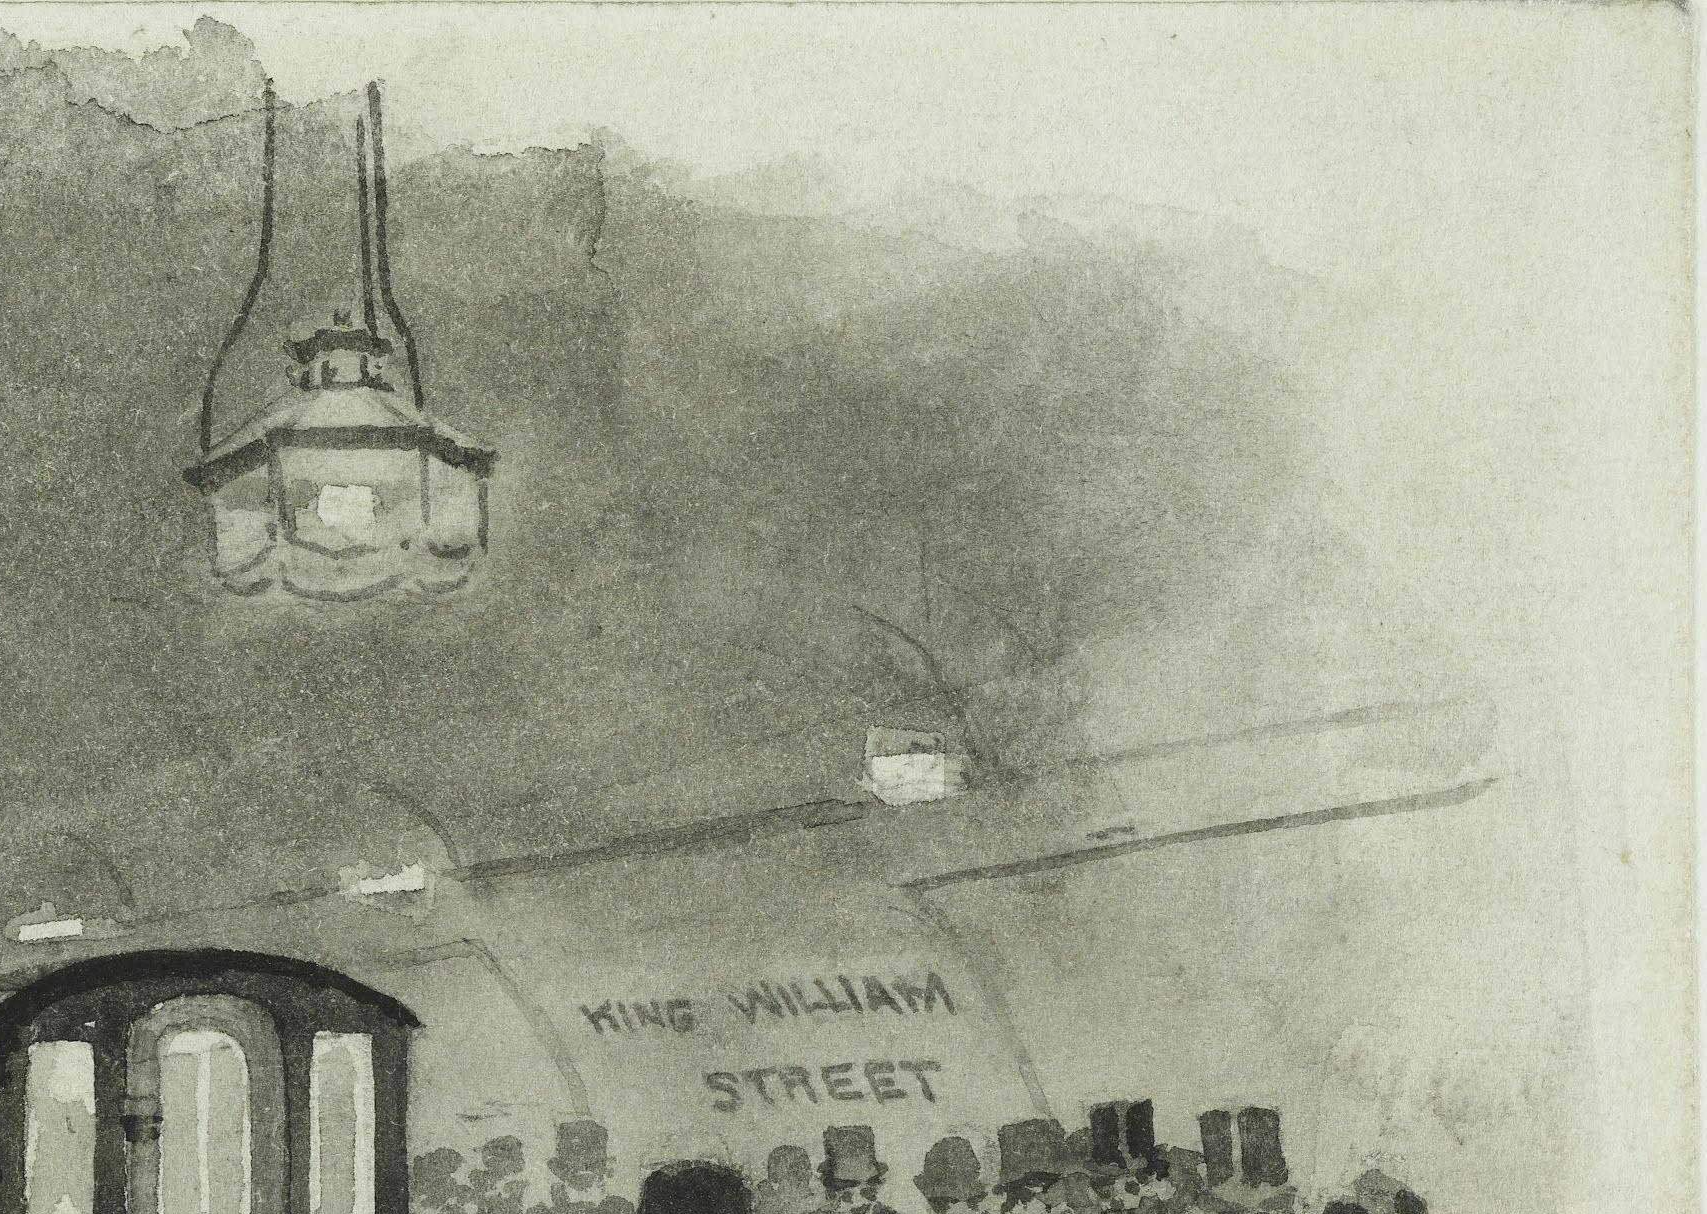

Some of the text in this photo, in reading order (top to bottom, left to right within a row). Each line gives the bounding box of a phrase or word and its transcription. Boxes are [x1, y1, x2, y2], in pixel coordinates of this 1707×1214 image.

[579, 971, 958, 1035] KING WILLIAM
[705, 1060, 942, 1113] STREET
